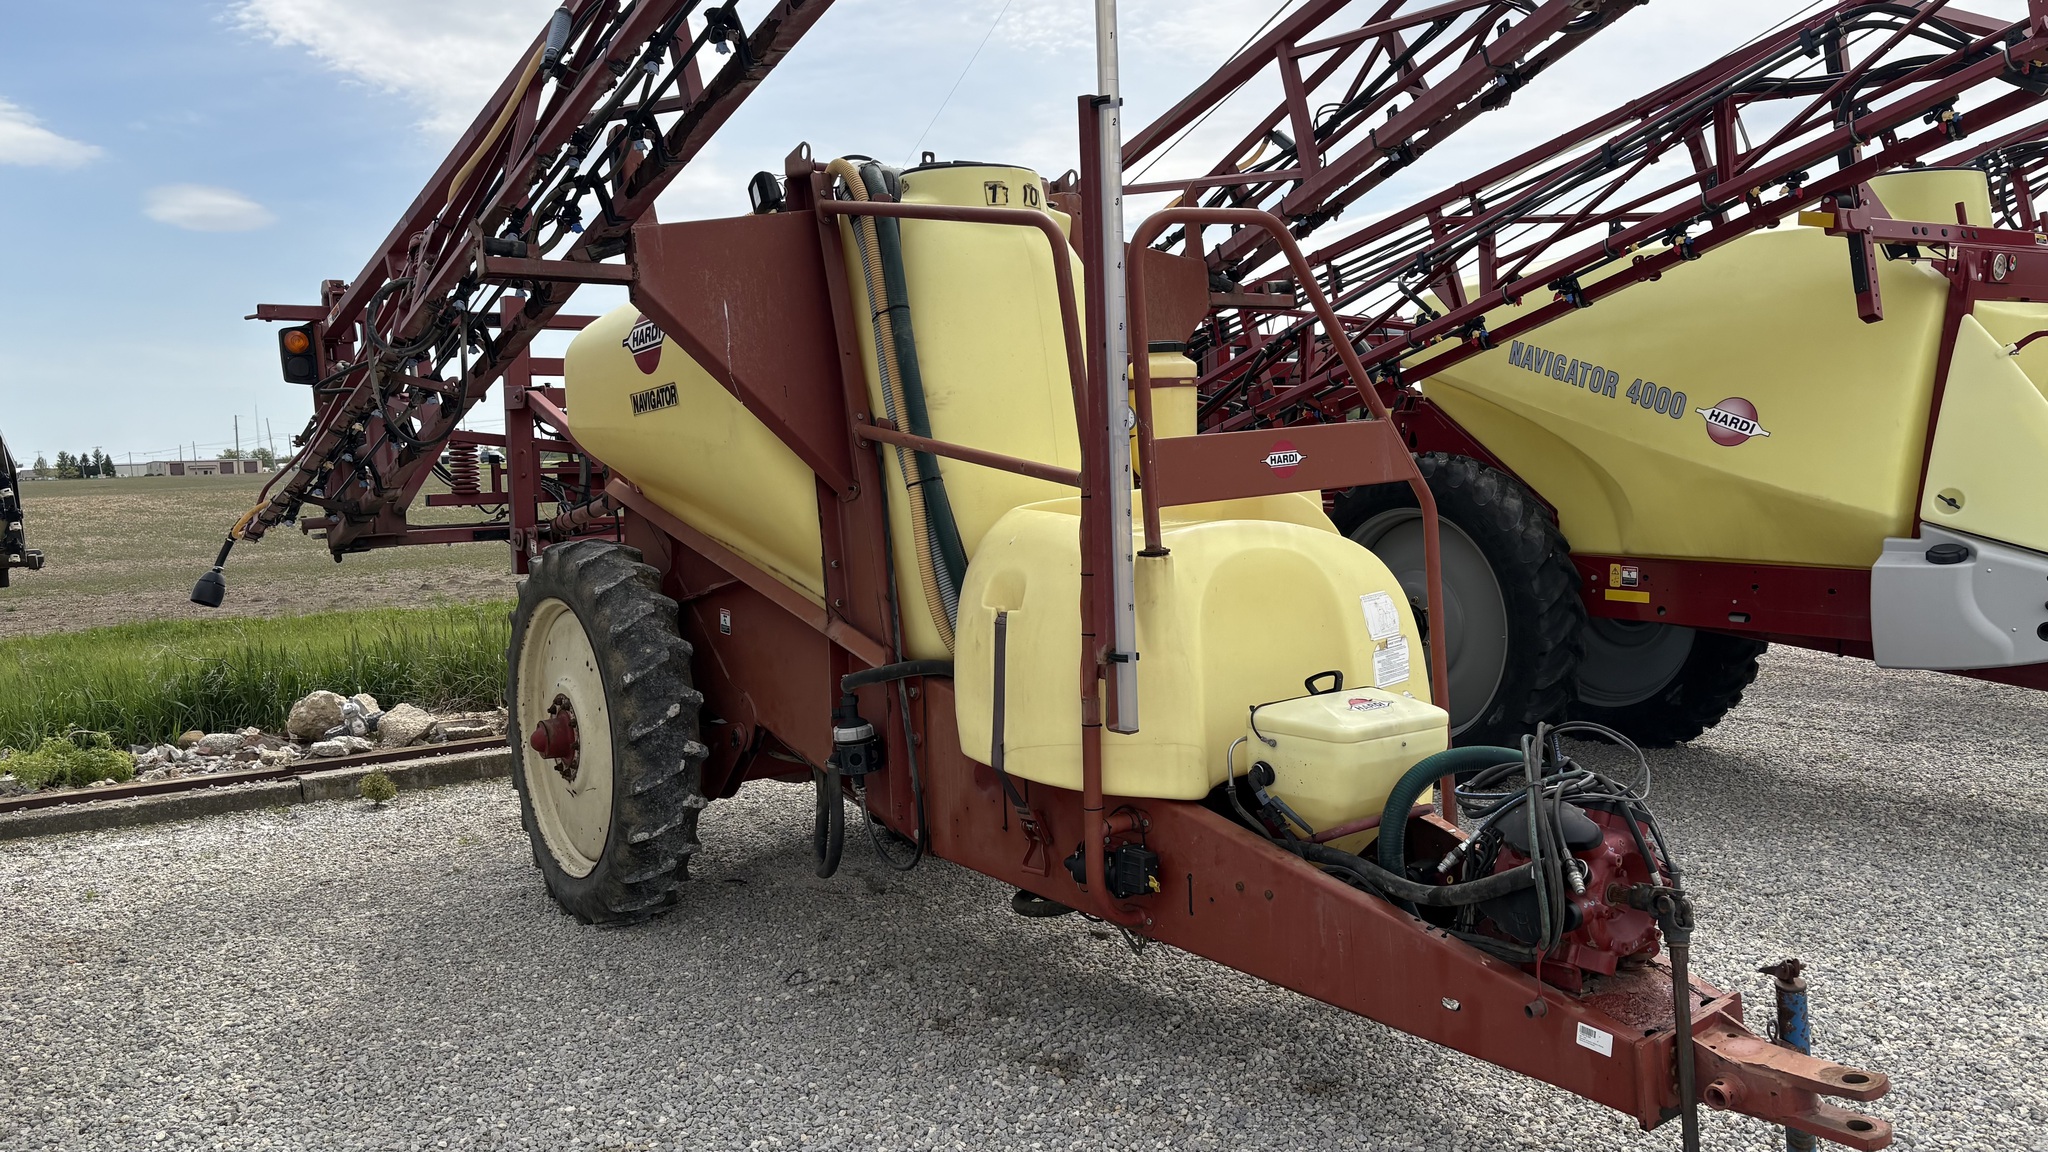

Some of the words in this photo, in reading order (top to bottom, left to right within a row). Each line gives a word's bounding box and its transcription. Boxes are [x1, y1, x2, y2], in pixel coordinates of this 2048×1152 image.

[632, 324, 662, 348] HARDI
[1508, 340, 1620, 399] NAVIGATOR
[1626, 378, 1688, 420] 4000
[632, 385, 677, 413] NAVIGATOR
[1707, 409, 1756, 434] HARDI
[1270, 453, 1298, 465] HARDI
